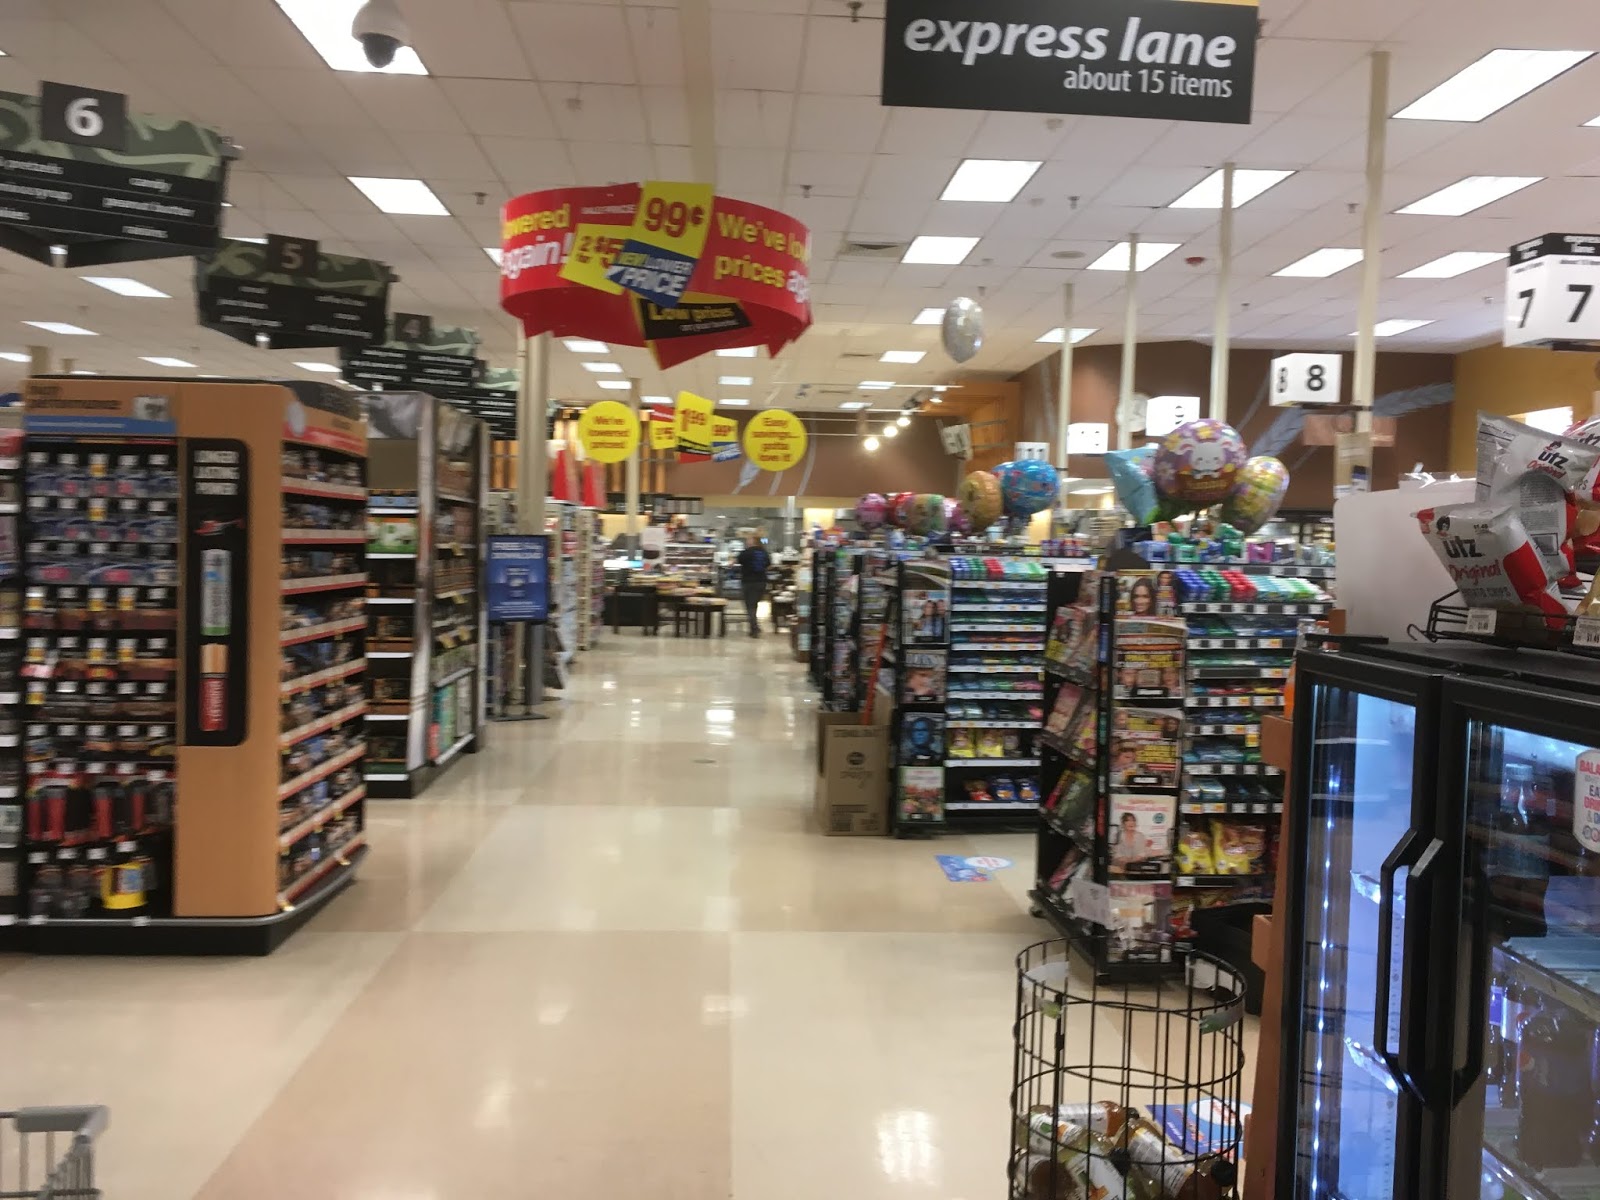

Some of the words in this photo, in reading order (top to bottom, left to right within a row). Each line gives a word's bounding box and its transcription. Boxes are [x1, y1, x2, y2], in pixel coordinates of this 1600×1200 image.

[903, 18, 1109, 66] express
[1118, 16, 1237, 68] lane
[1062, 64, 1133, 93] about
[1139, 69, 1165, 95] 15
[1169, 71, 1233, 99] items
[64, 97, 103, 138] 6
[715, 212, 787, 252] We've
[279, 243, 304, 271] 5
[713, 254, 787, 289] prices
[618, 266, 689, 298] PRICE
[1517, 287, 1537, 329] 7
[1567, 284, 1595, 324] 7
[1305, 364, 1328, 392] 8
[1537, 450, 1570, 470] utz
[1442, 535, 1483, 559] utz
[1447, 558, 1502, 586] Original
